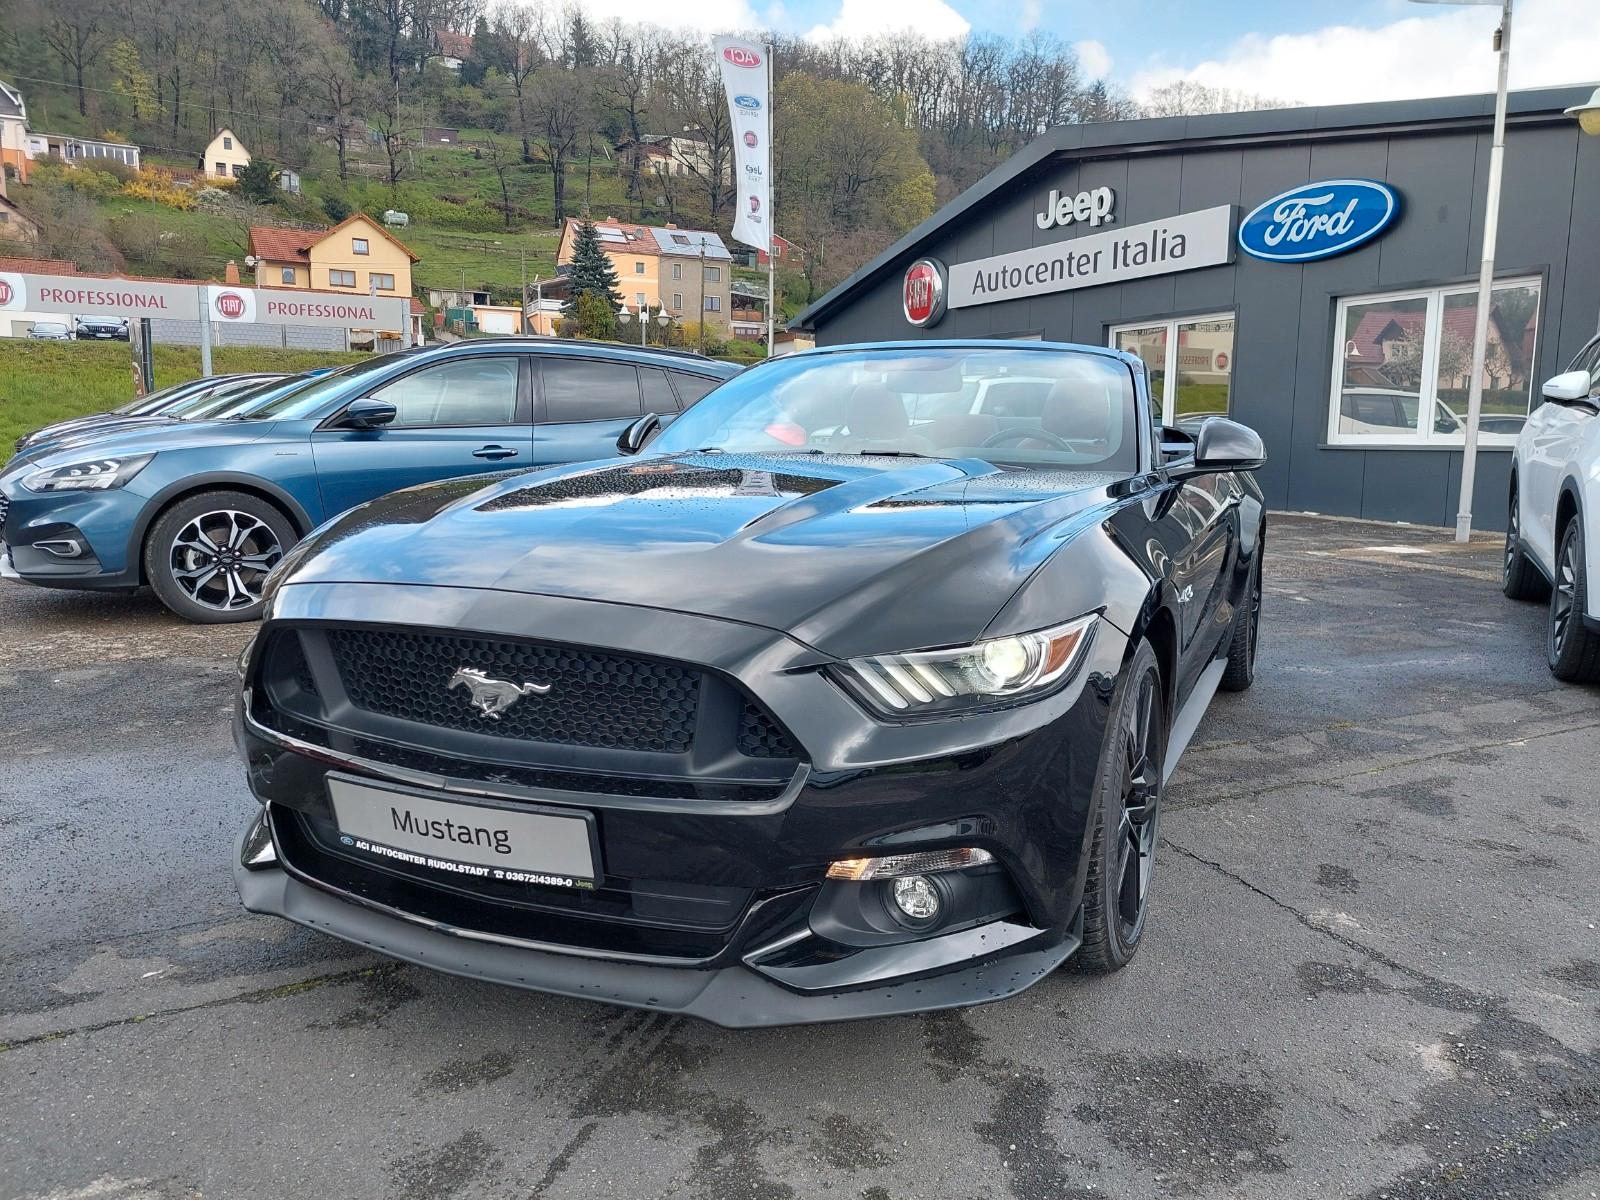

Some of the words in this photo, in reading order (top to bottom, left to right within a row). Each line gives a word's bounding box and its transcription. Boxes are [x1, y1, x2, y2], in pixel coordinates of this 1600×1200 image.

[1037, 186, 1113, 230] Jeep
[1264, 193, 1359, 247] Ford
[972, 249, 1103, 295] Autocenter
[1112, 228, 1187, 270] Italia
[40, 288, 168, 309] PROFESSIONAL
[223, 299, 240, 313] FIAT
[268, 301, 376, 321] PROFESSIONAL
[391, 807, 512, 855] Mustang
[356, 840, 370, 851] ACI
[371, 845, 426, 865] AUTOCENTER
[428, 858, 490, 877] RUDOLSTADT
